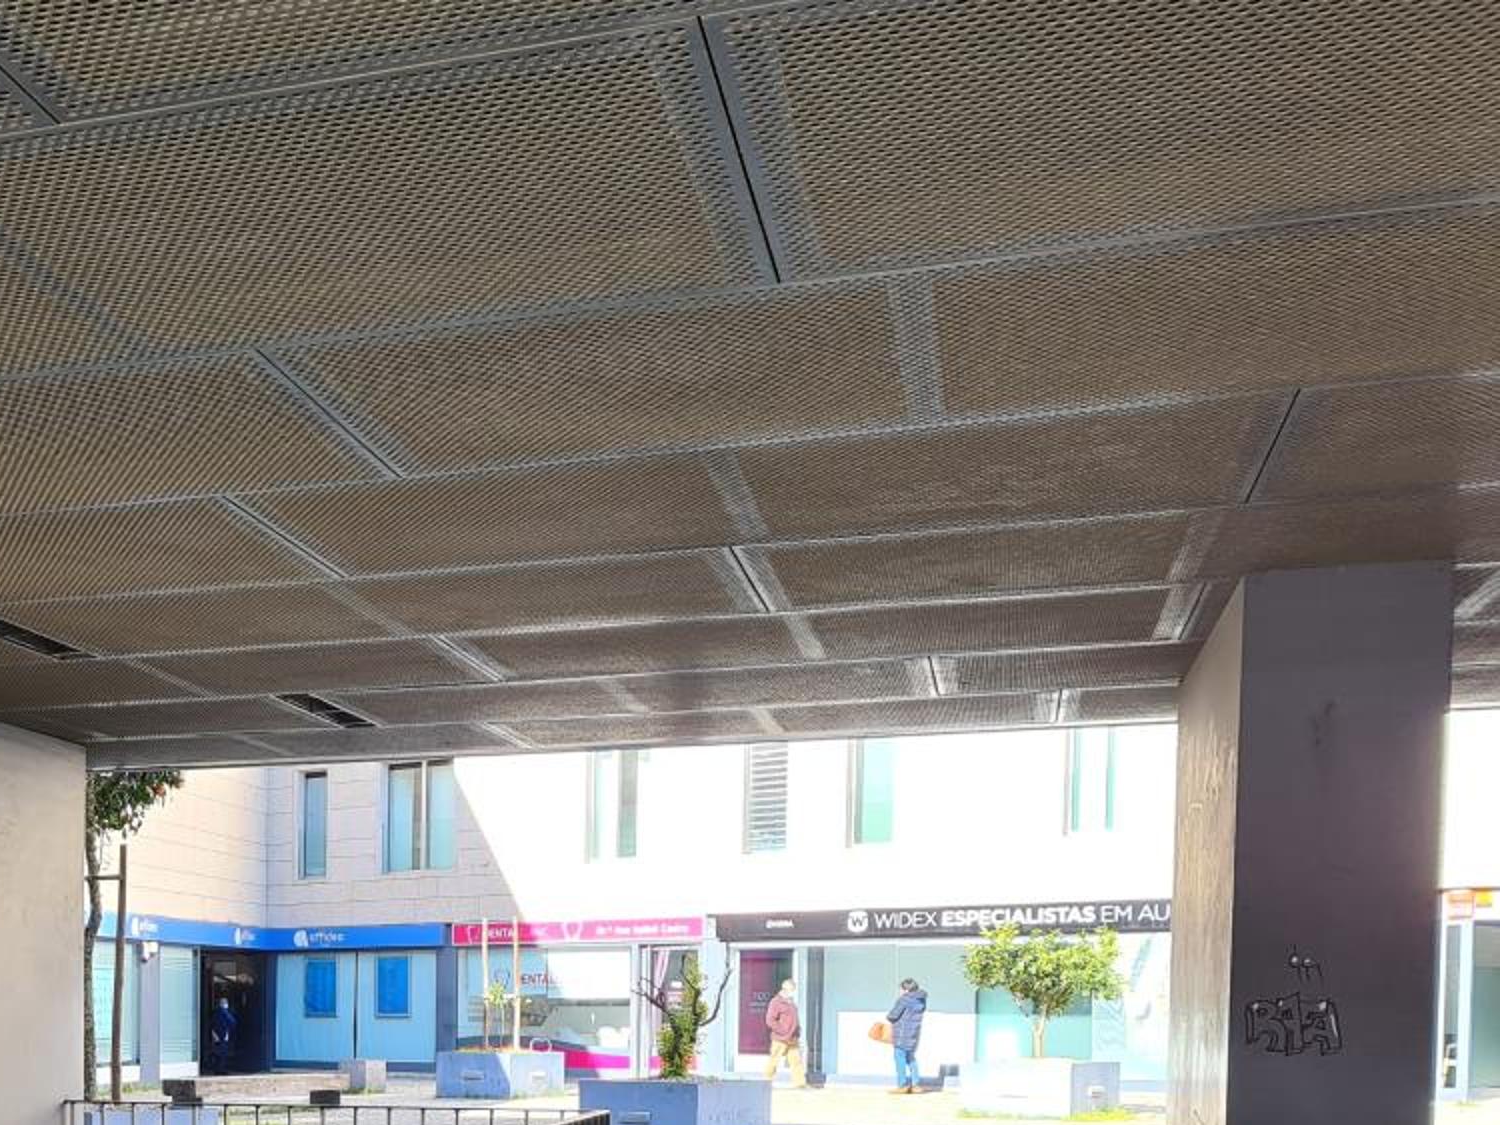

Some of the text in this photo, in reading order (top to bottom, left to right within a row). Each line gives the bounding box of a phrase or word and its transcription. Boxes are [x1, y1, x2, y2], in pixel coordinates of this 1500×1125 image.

[873, 911, 938, 929] WIDEX
[941, 904, 1097, 927] ESPECIALISTAS
[1101, 905, 1133, 922] EM
